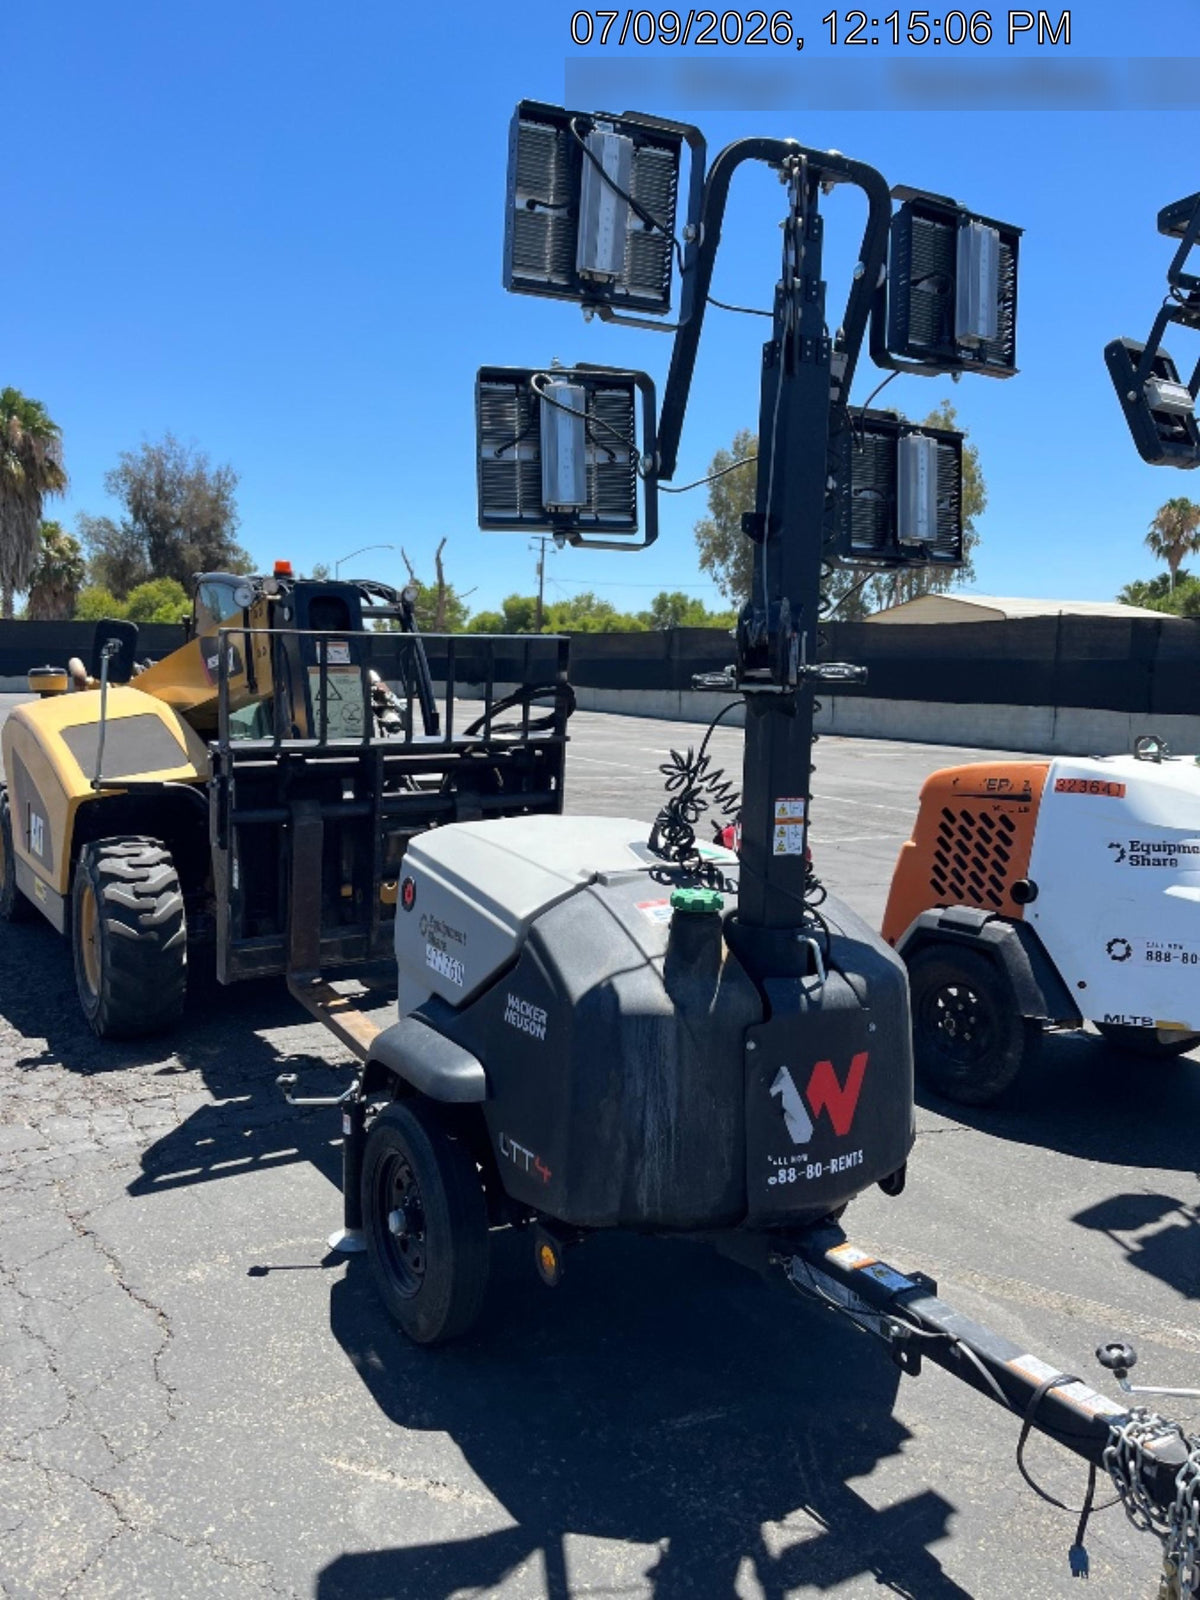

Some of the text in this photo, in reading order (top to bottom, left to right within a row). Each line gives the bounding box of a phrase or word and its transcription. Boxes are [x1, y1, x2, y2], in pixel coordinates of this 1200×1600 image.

[1129, 855, 1179, 868] Share
[504, 1007, 547, 1041] NEUSON
[508, 992, 549, 1025] WACKER
